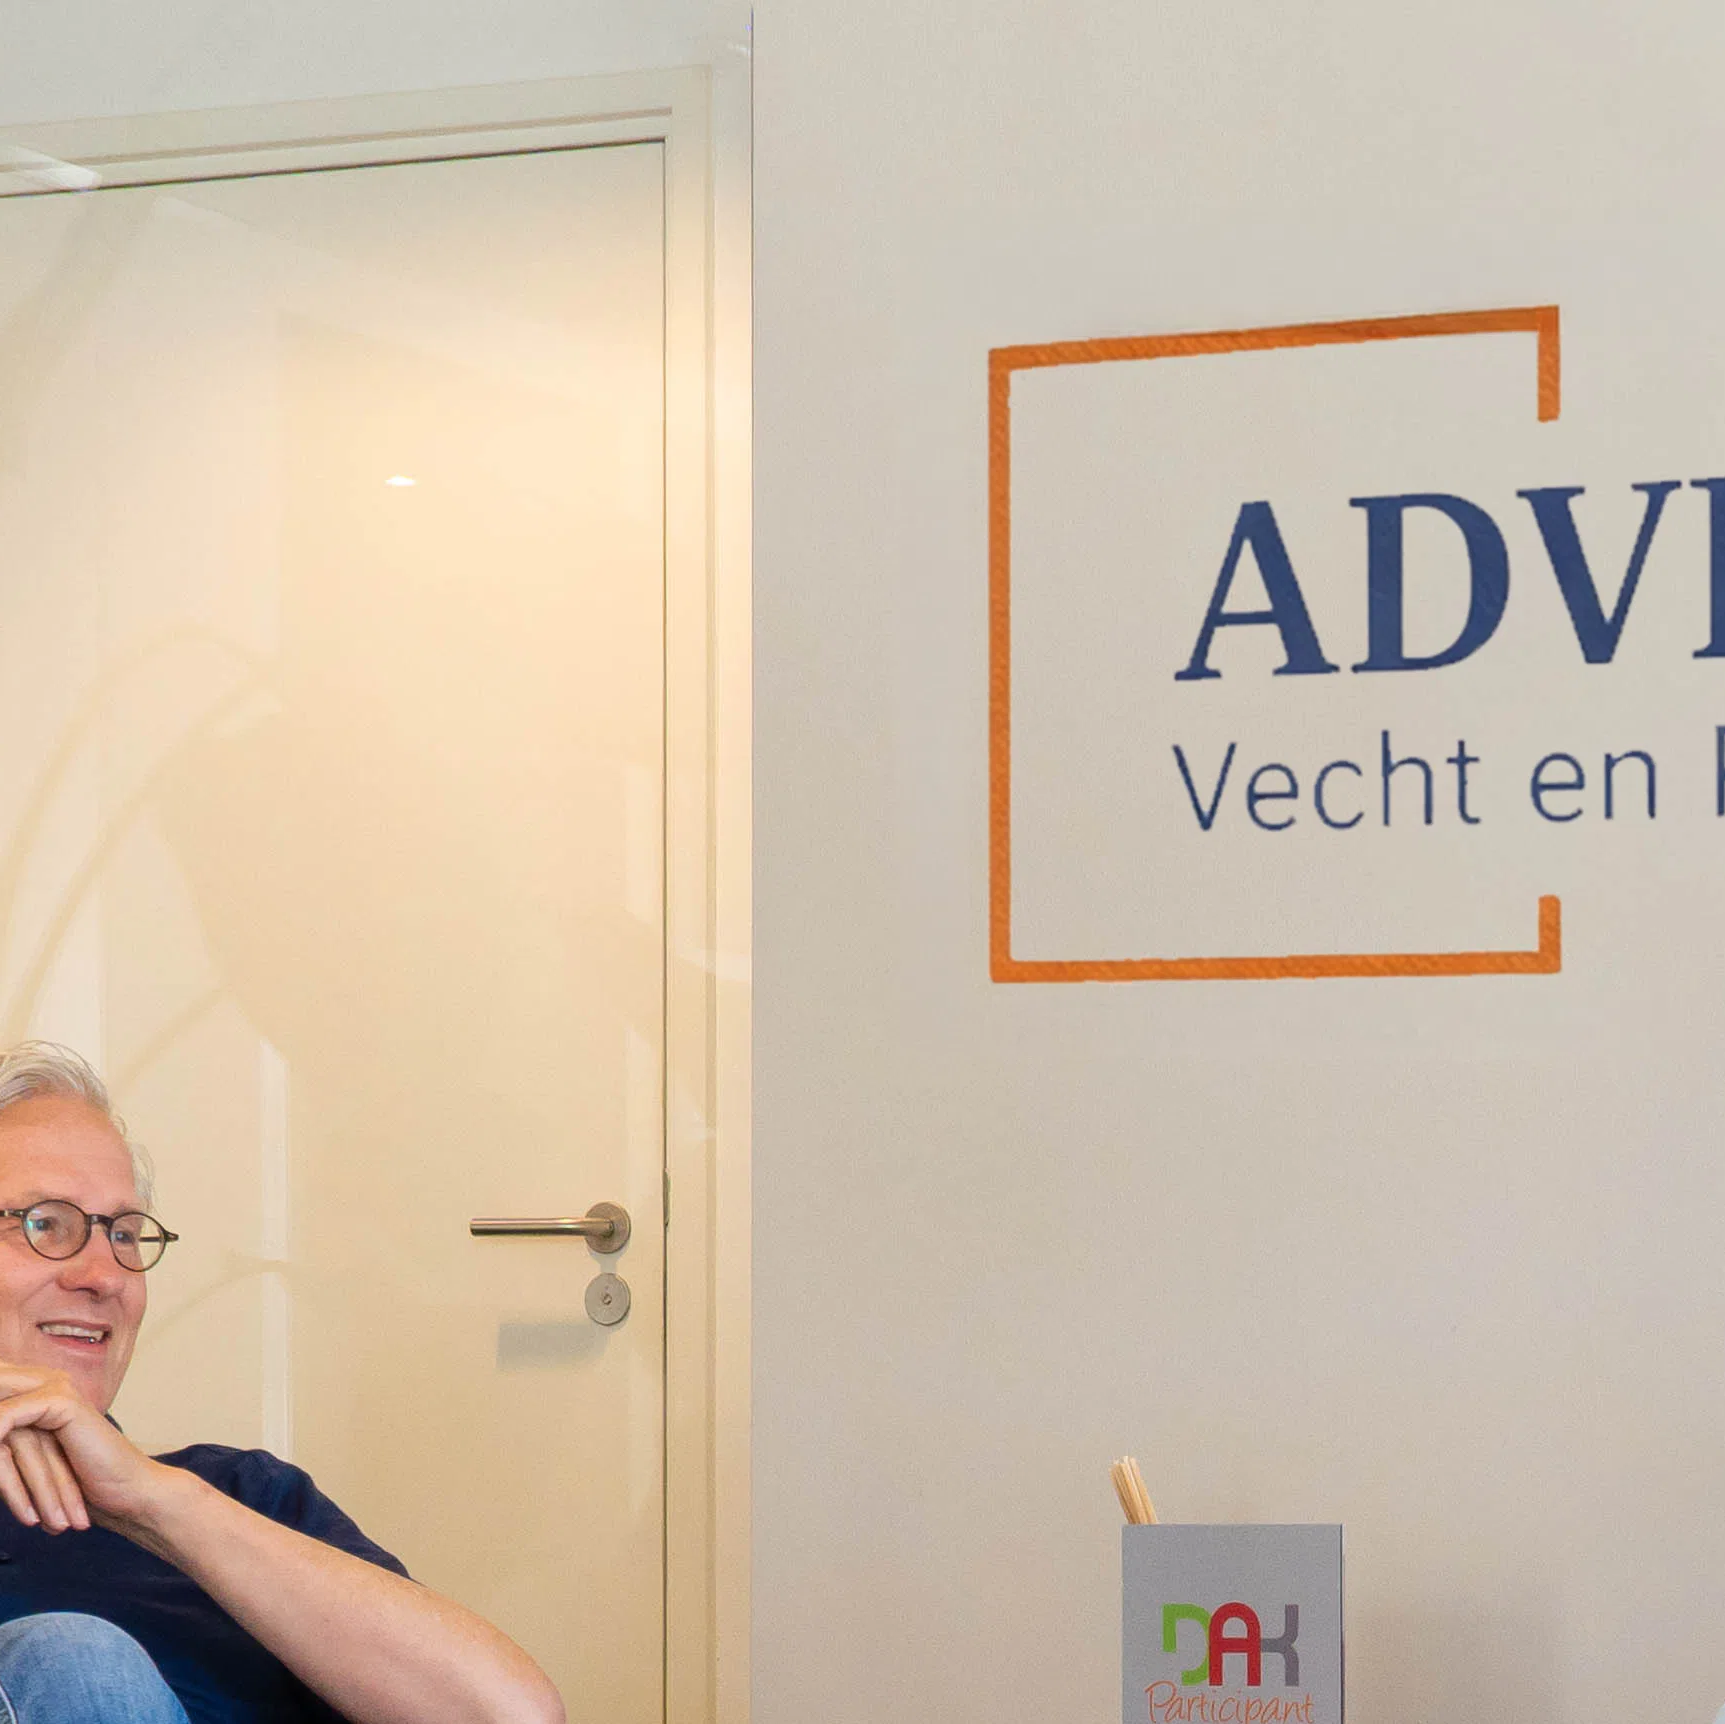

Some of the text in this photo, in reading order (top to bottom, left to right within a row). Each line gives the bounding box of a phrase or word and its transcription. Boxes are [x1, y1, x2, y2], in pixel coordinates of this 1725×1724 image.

[1171, 728, 1481, 833] Vecht
[1529, 750, 1657, 824] en
[1162, 1602, 1300, 1687] DAK
